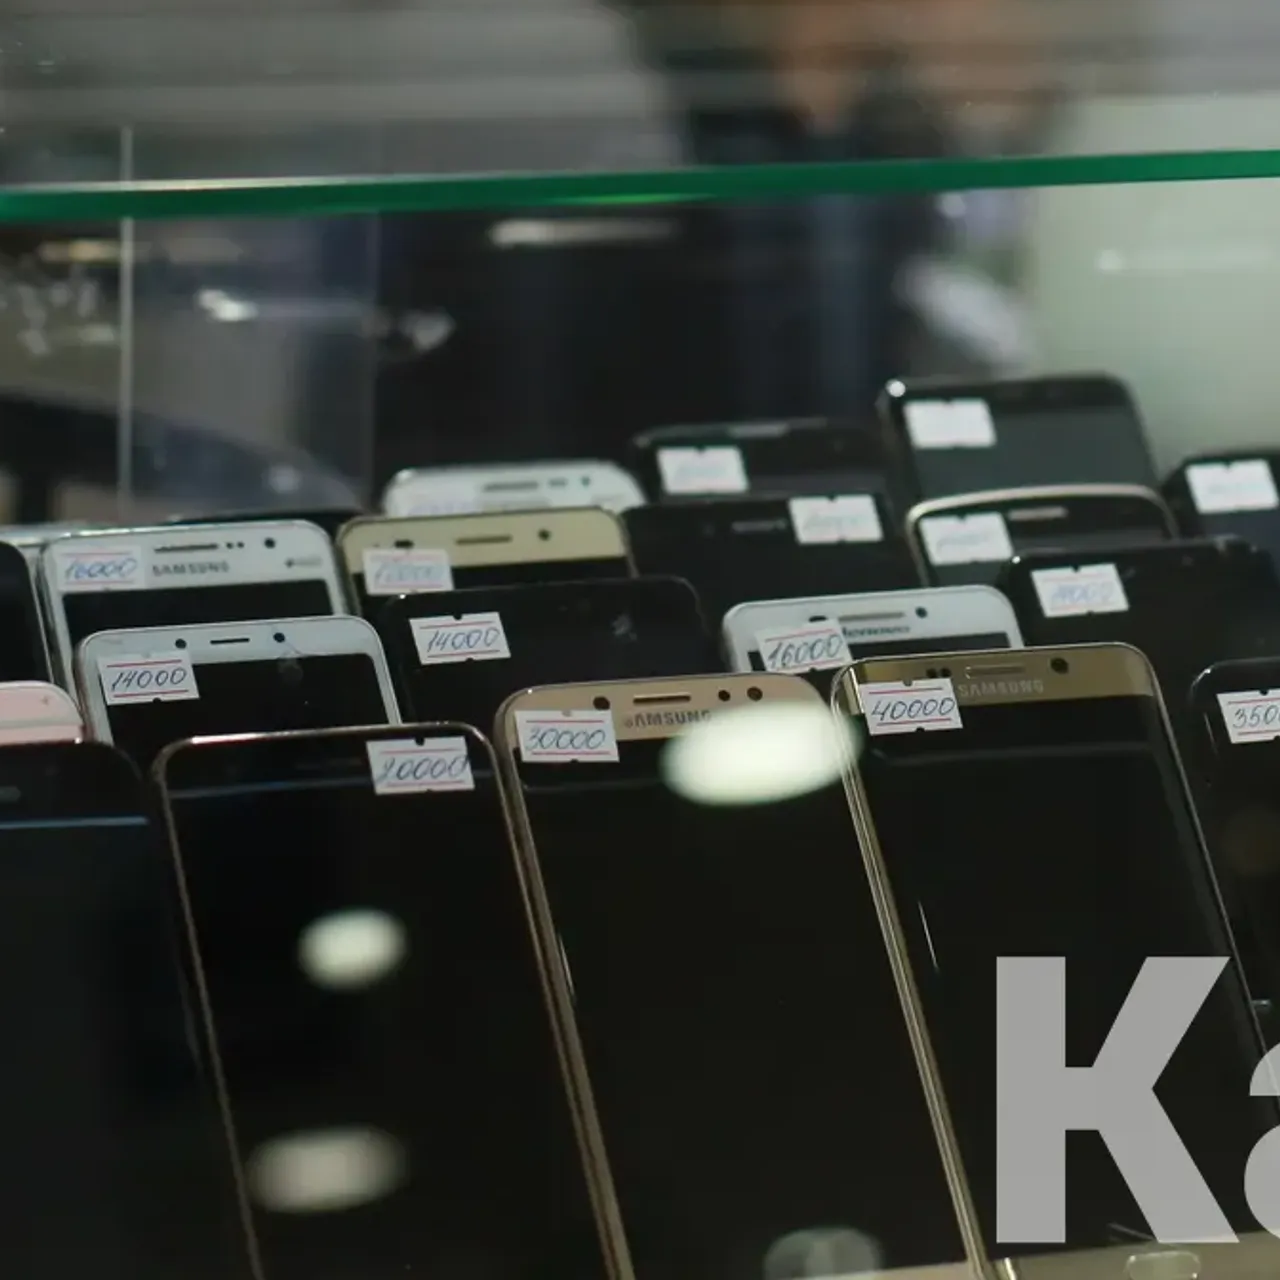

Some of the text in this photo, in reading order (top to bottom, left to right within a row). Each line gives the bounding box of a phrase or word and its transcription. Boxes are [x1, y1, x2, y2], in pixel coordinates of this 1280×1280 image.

[152, 560, 230, 577] SAMSUNG
[427, 626, 501, 652] 14000
[767, 634, 843, 669] 16000
[111, 667, 188, 691] 14000
[958, 679, 1044, 698] SAMSUNG
[871, 697, 956, 721] 40000
[525, 728, 606, 751] 30000
